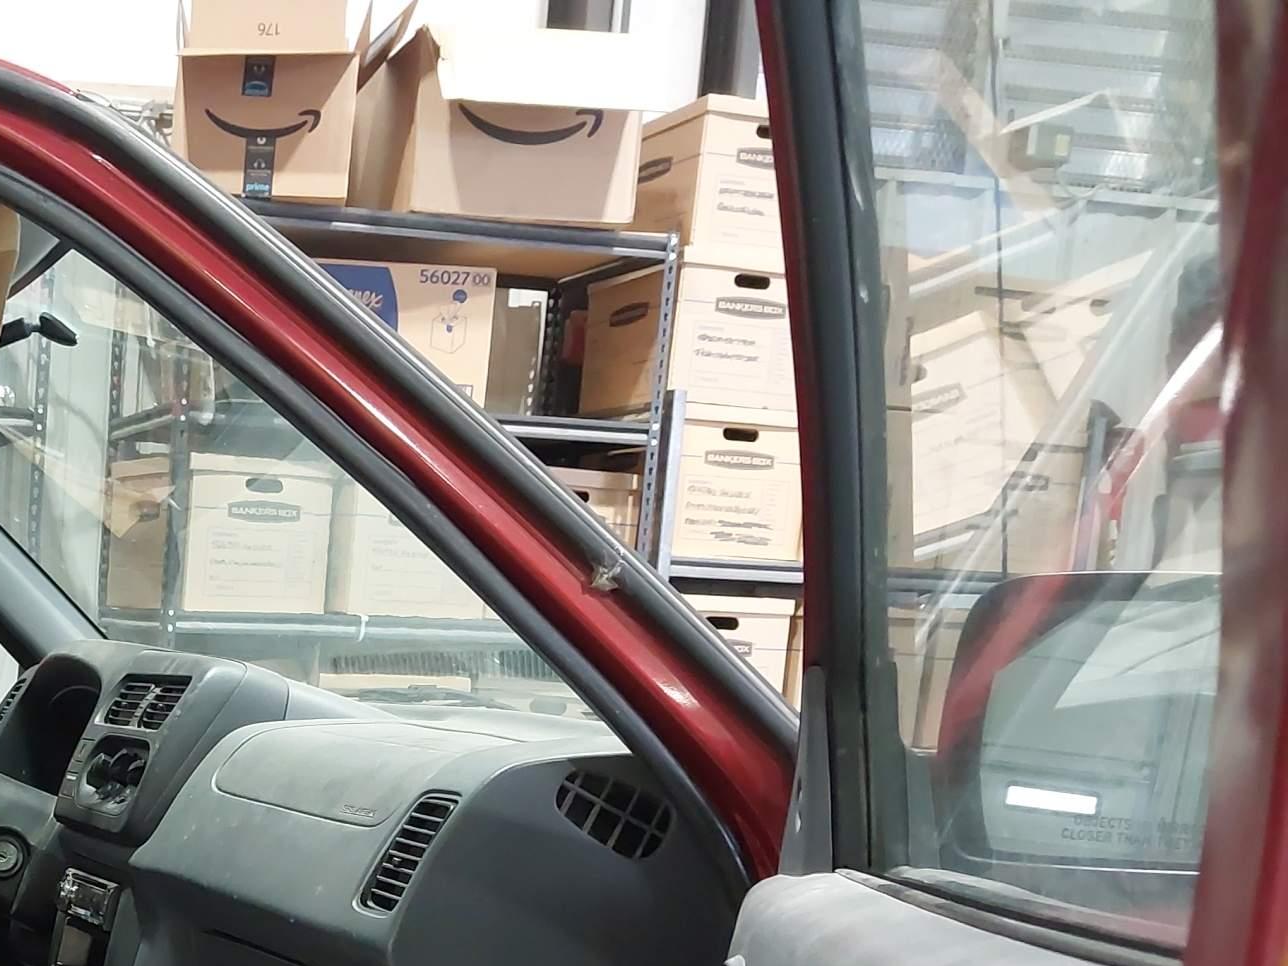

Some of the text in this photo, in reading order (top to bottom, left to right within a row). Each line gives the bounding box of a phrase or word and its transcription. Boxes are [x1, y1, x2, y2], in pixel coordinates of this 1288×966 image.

[257, 22, 280, 36] 176
[245, 181, 270, 192] prime
[419, 268, 491, 287] 56027 00
[718, 301, 784, 315] BANKERS BOX
[707, 454, 773, 467] BANKERS BOX
[1061, 827, 1113, 842] CLOSER
